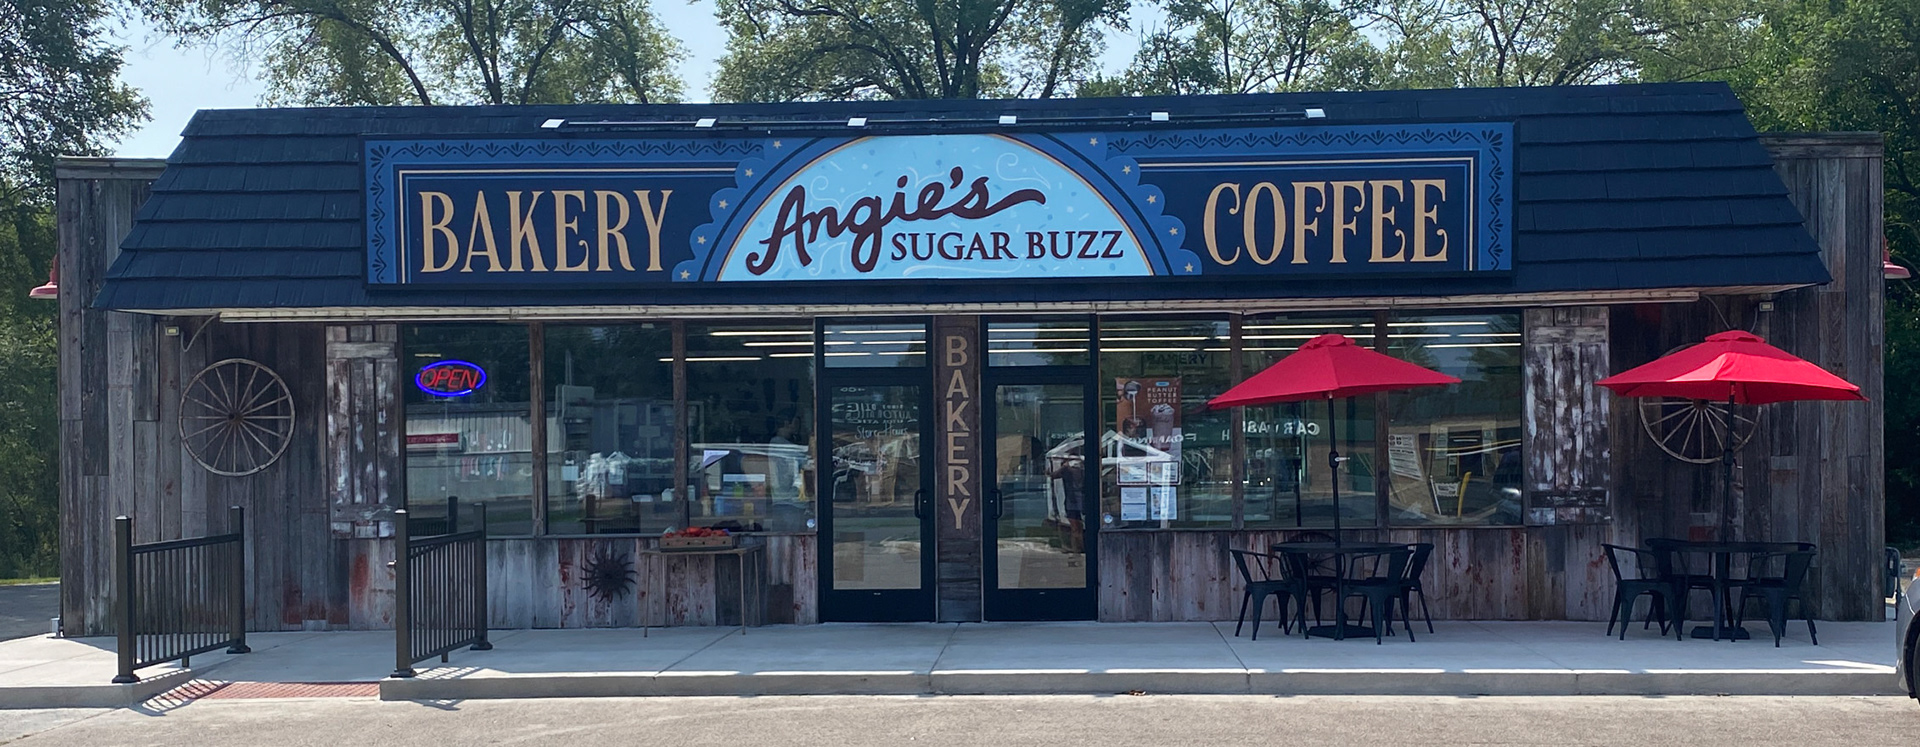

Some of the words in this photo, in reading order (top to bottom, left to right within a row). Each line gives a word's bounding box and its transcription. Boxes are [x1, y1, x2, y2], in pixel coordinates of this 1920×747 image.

[419, 189, 673, 273] BAKERY
[745, 166, 1046, 275] Angie's
[891, 231, 1018, 261] SUGAR
[1026, 230, 1124, 260] BUZZ
[1203, 179, 1448, 265] COFFEE
[420, 368, 479, 389] OPEN
[945, 335, 971, 530] BAKERY
